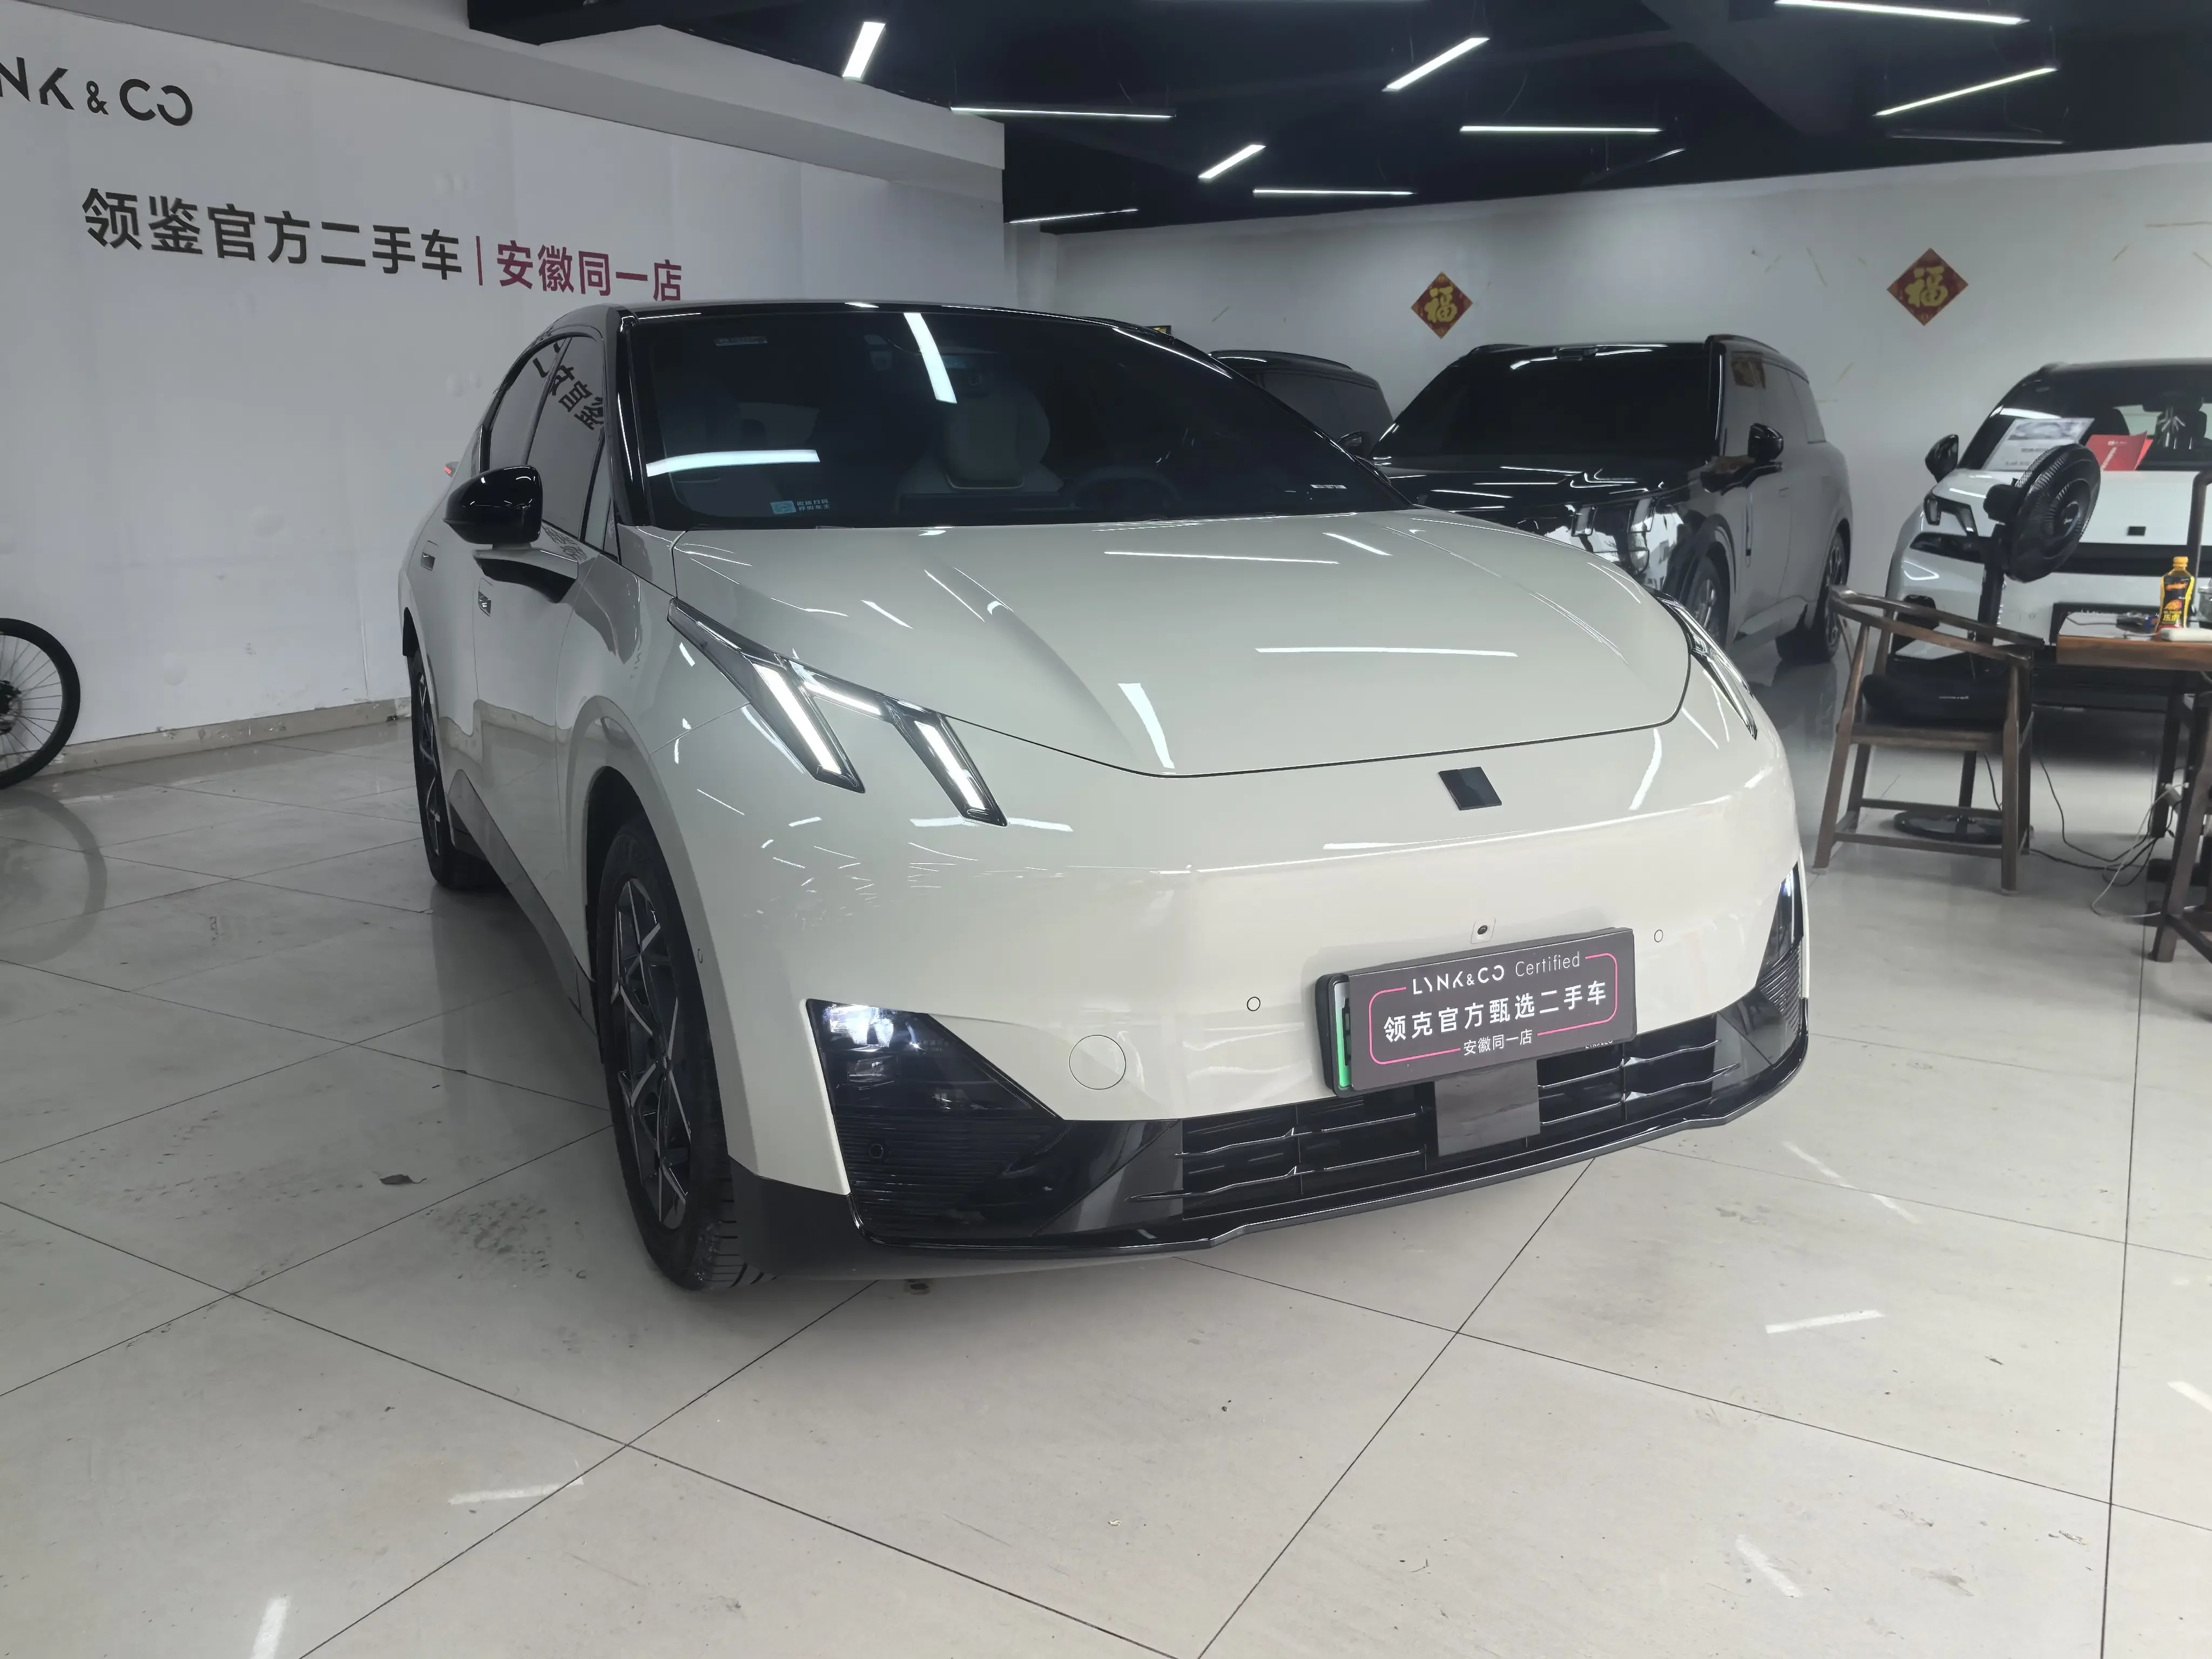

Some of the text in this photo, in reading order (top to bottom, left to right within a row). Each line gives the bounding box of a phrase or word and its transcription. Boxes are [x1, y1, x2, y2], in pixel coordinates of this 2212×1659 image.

[82, 187, 682, 301] 领鉴官方二手车 安徽同一店
[1424, 286, 1458, 323] 福
[1905, 266, 1948, 308] 福
[1413, 952, 1580, 995] LYNK&CO Certified
[1384, 981, 1607, 1043] 领克官方甄选二手车
[1464, 1029, 1533, 1056] 安徽同一店
